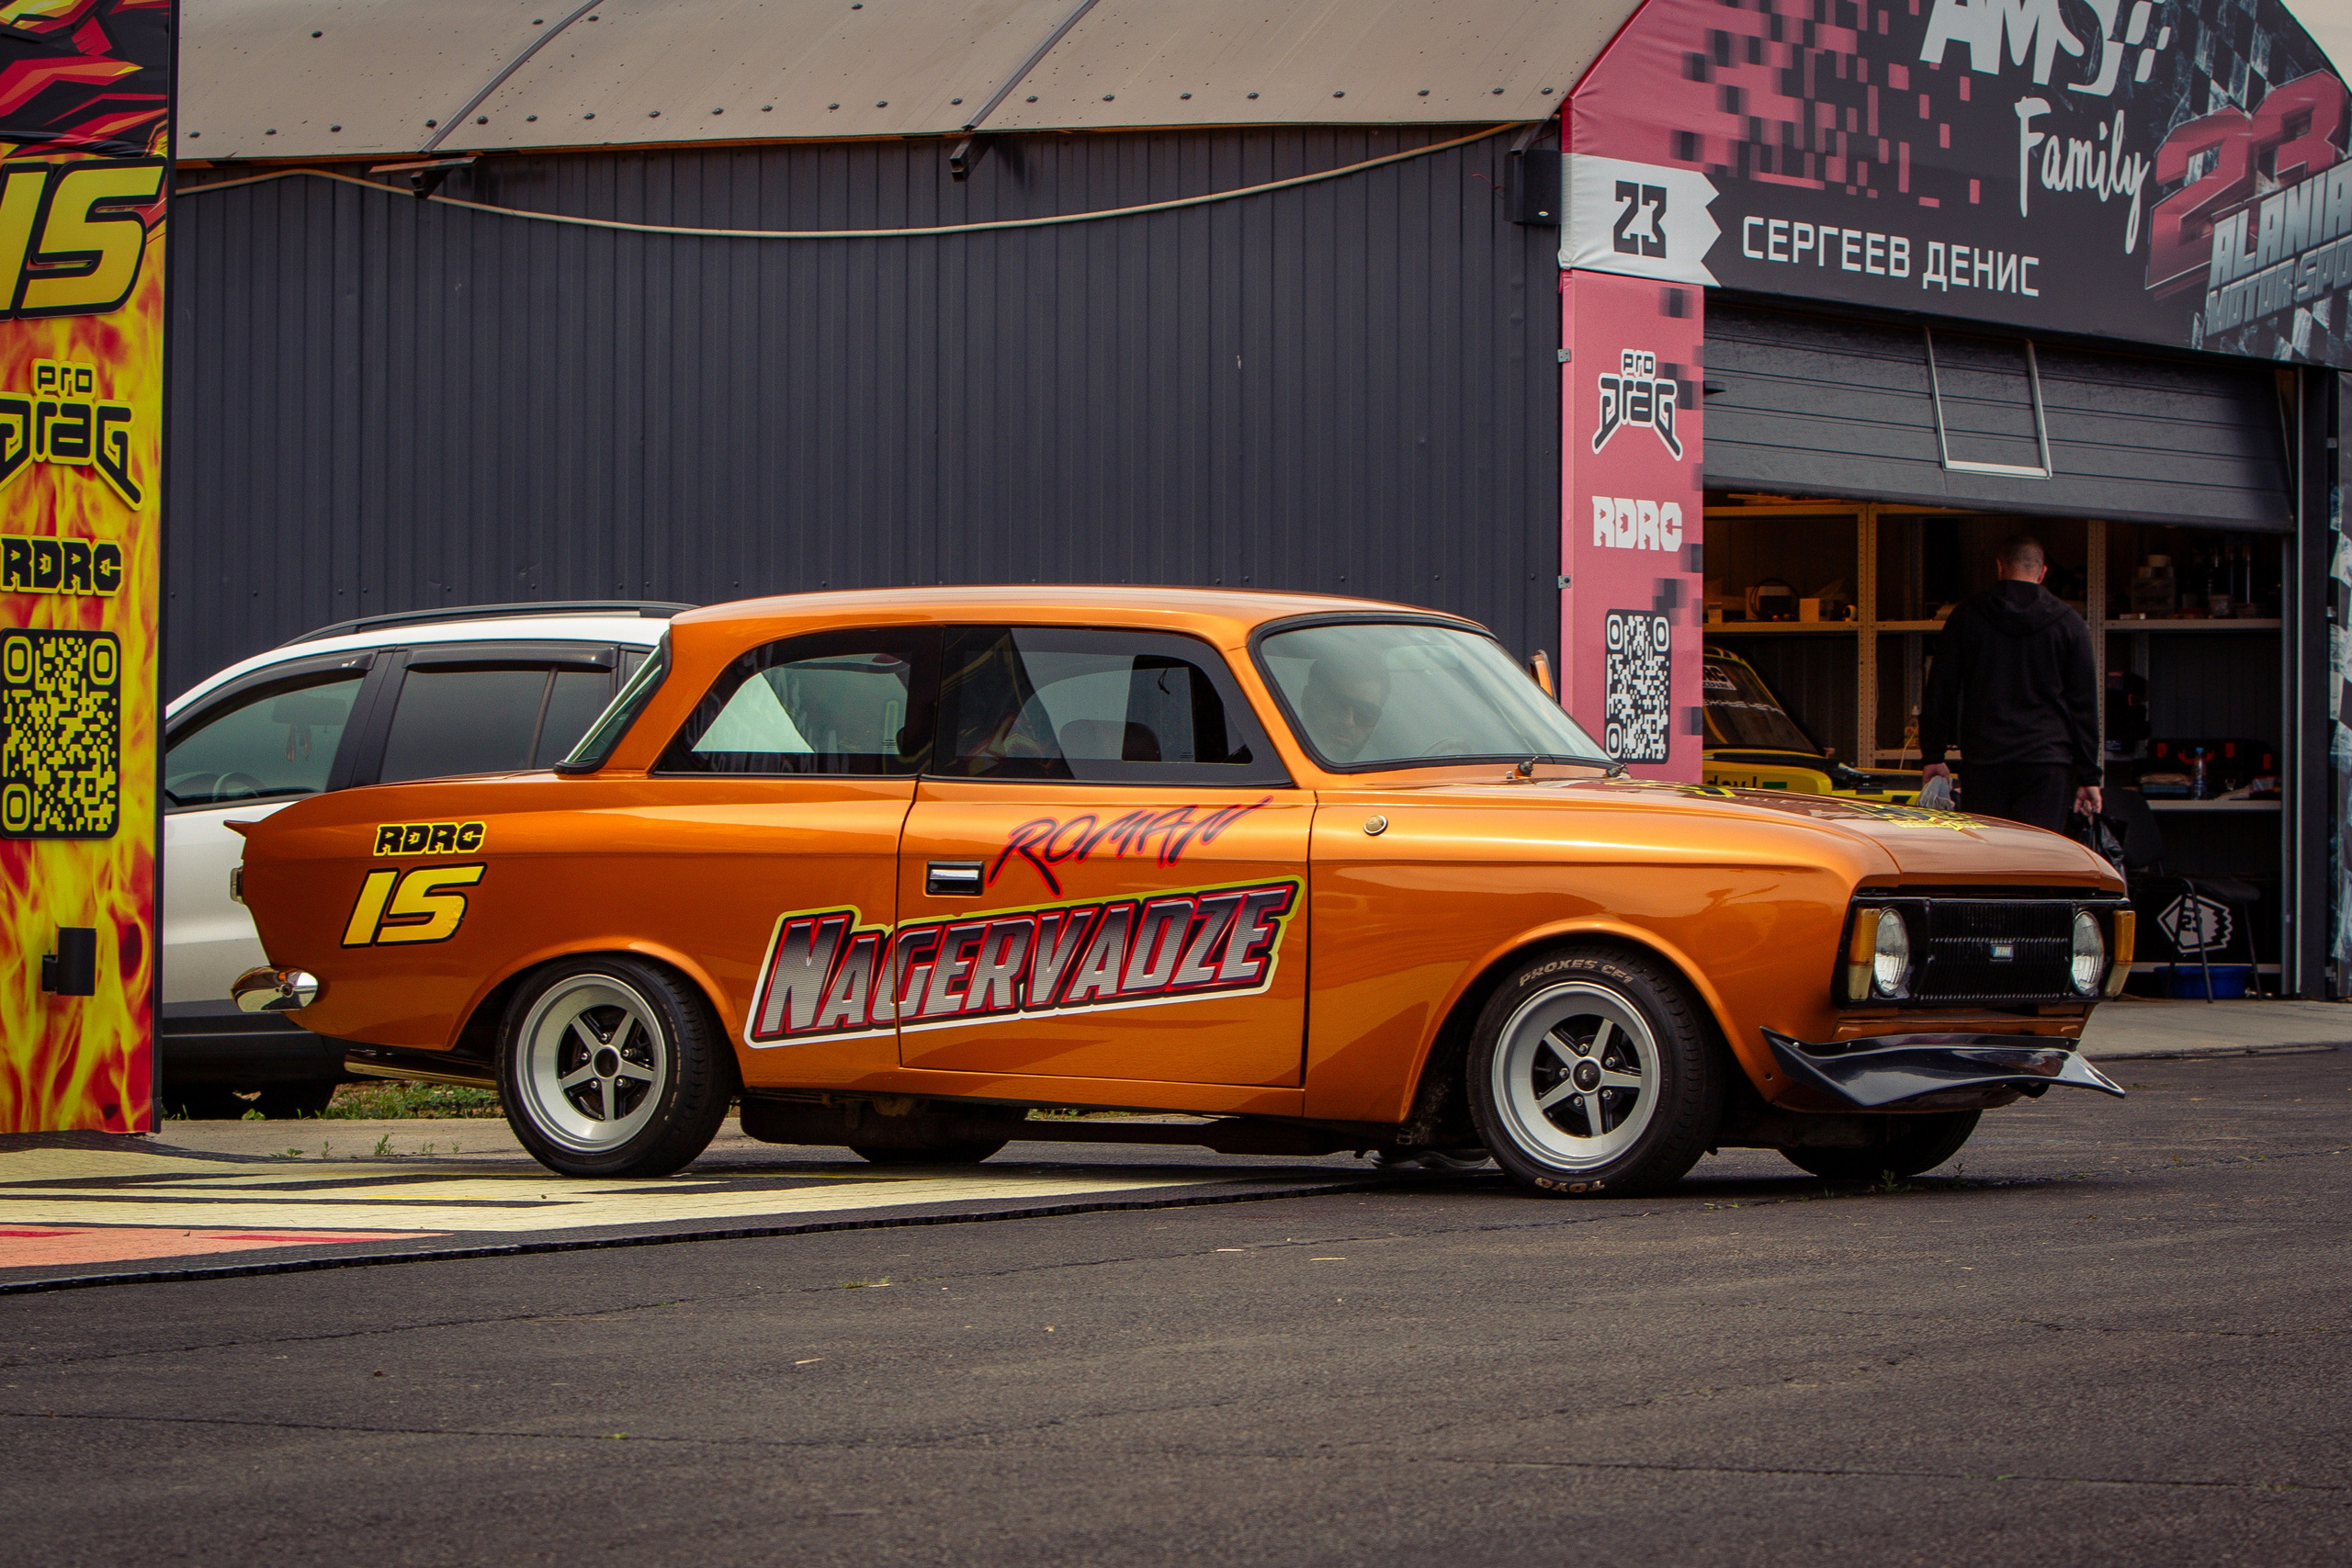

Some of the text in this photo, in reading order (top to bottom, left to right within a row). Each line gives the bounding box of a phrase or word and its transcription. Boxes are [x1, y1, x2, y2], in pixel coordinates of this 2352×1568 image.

[2014, 96, 2151, 254] Family
[1612, 180, 1668, 259] 23
[1743, 215, 2039, 297] СЕРГЕЕВ ДЕНИС
[2209, 160, 2352, 289] ALANIA
[1591, 496, 1682, 552] RDRC
[0, 536, 122, 593] RDRC
[373, 821, 488, 857] RDRC
[986, 795, 1274, 897] ROMAN
[752, 884, 1295, 1038] NAGERVADZE
[1520, 959, 1599, 987] PROXES
[1534, 1177, 1605, 1193] TOYO
